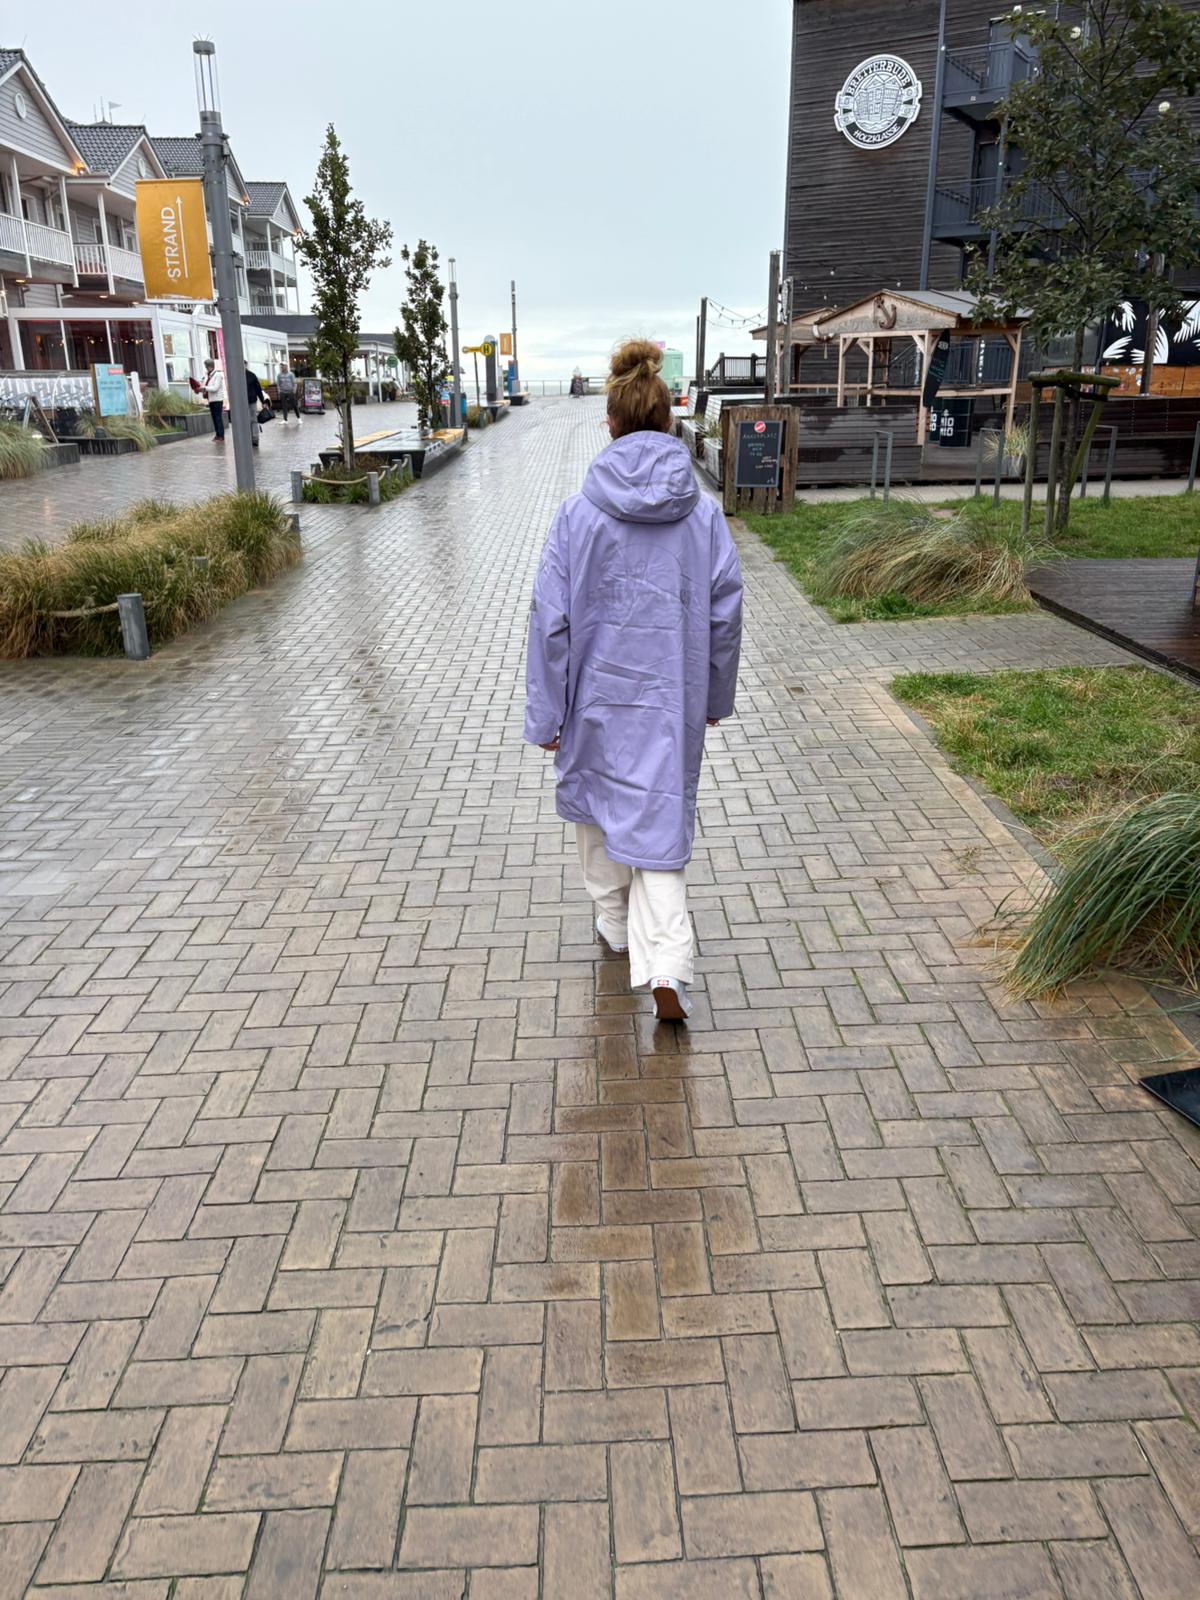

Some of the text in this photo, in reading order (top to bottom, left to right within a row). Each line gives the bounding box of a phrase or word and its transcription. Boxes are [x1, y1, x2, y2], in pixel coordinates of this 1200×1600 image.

[848, 60, 911, 96] BRETTERBUDE
[853, 124, 900, 142] HOLZKLASSE
[161, 207, 181, 279] STRAND
